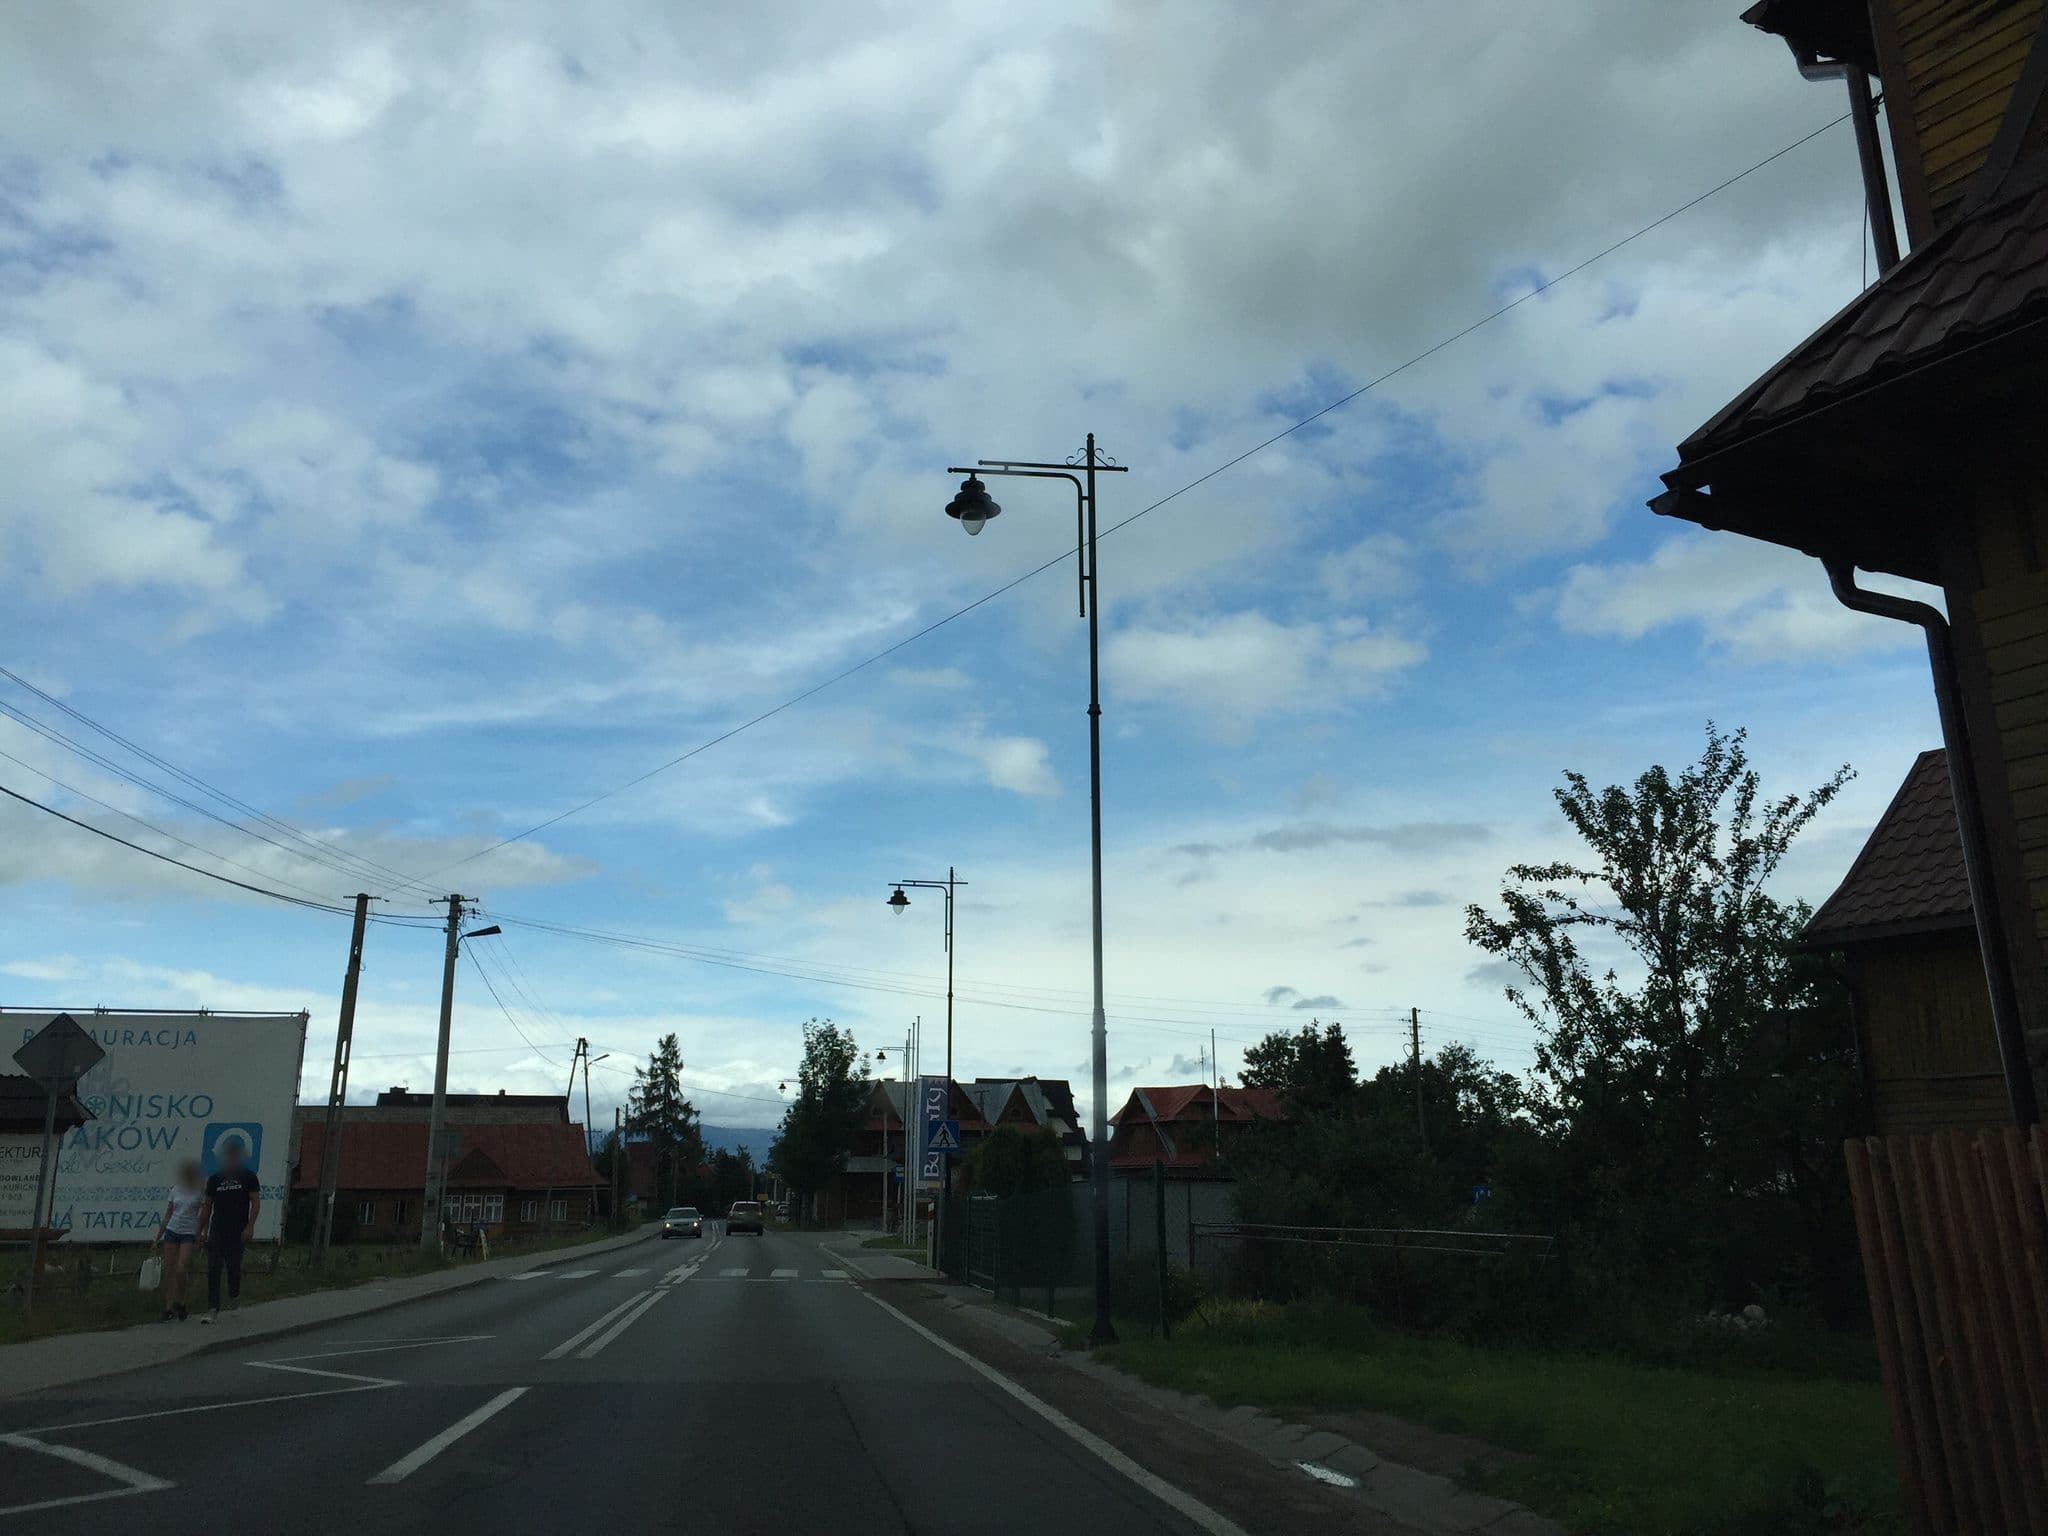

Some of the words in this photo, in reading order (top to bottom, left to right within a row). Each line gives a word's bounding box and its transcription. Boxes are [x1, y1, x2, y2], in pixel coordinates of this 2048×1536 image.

[22, 1028, 198, 1049] RAURACJA
[86, 1094, 214, 1119] ONISKO
[66, 1121, 181, 1151] AKÓW
[0, 1146, 42, 1159] EKTUR
[83, 1211, 162, 1230] TATRZA
